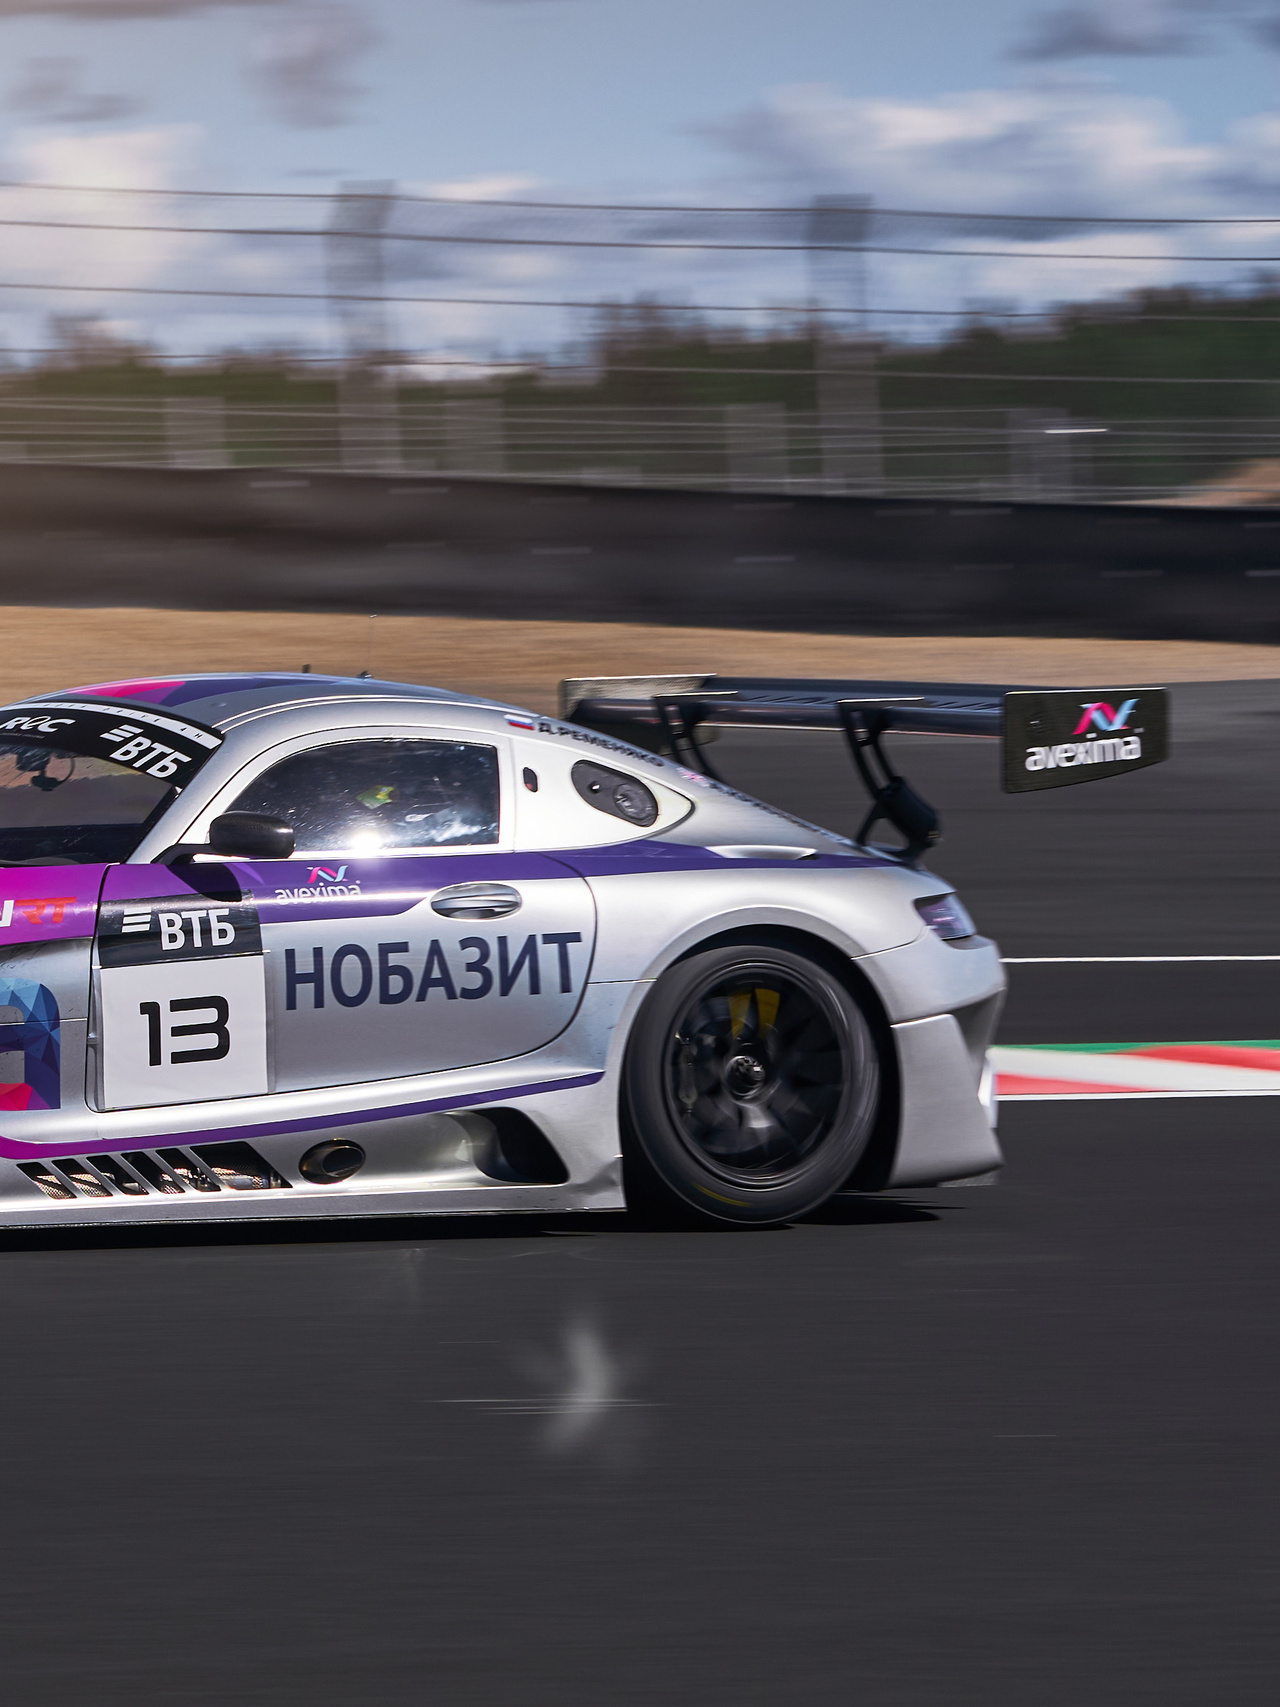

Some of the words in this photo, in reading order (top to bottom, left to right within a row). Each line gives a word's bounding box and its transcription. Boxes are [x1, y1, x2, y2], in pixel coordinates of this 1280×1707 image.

[109, 735, 193, 779] ВТБ
[1024, 732, 1142, 772] avexima
[274, 879, 362, 906] avexima
[158, 907, 237, 951] ВТБ
[284, 931, 583, 1010] НОБАЗИТ
[139, 995, 231, 1067] 13
